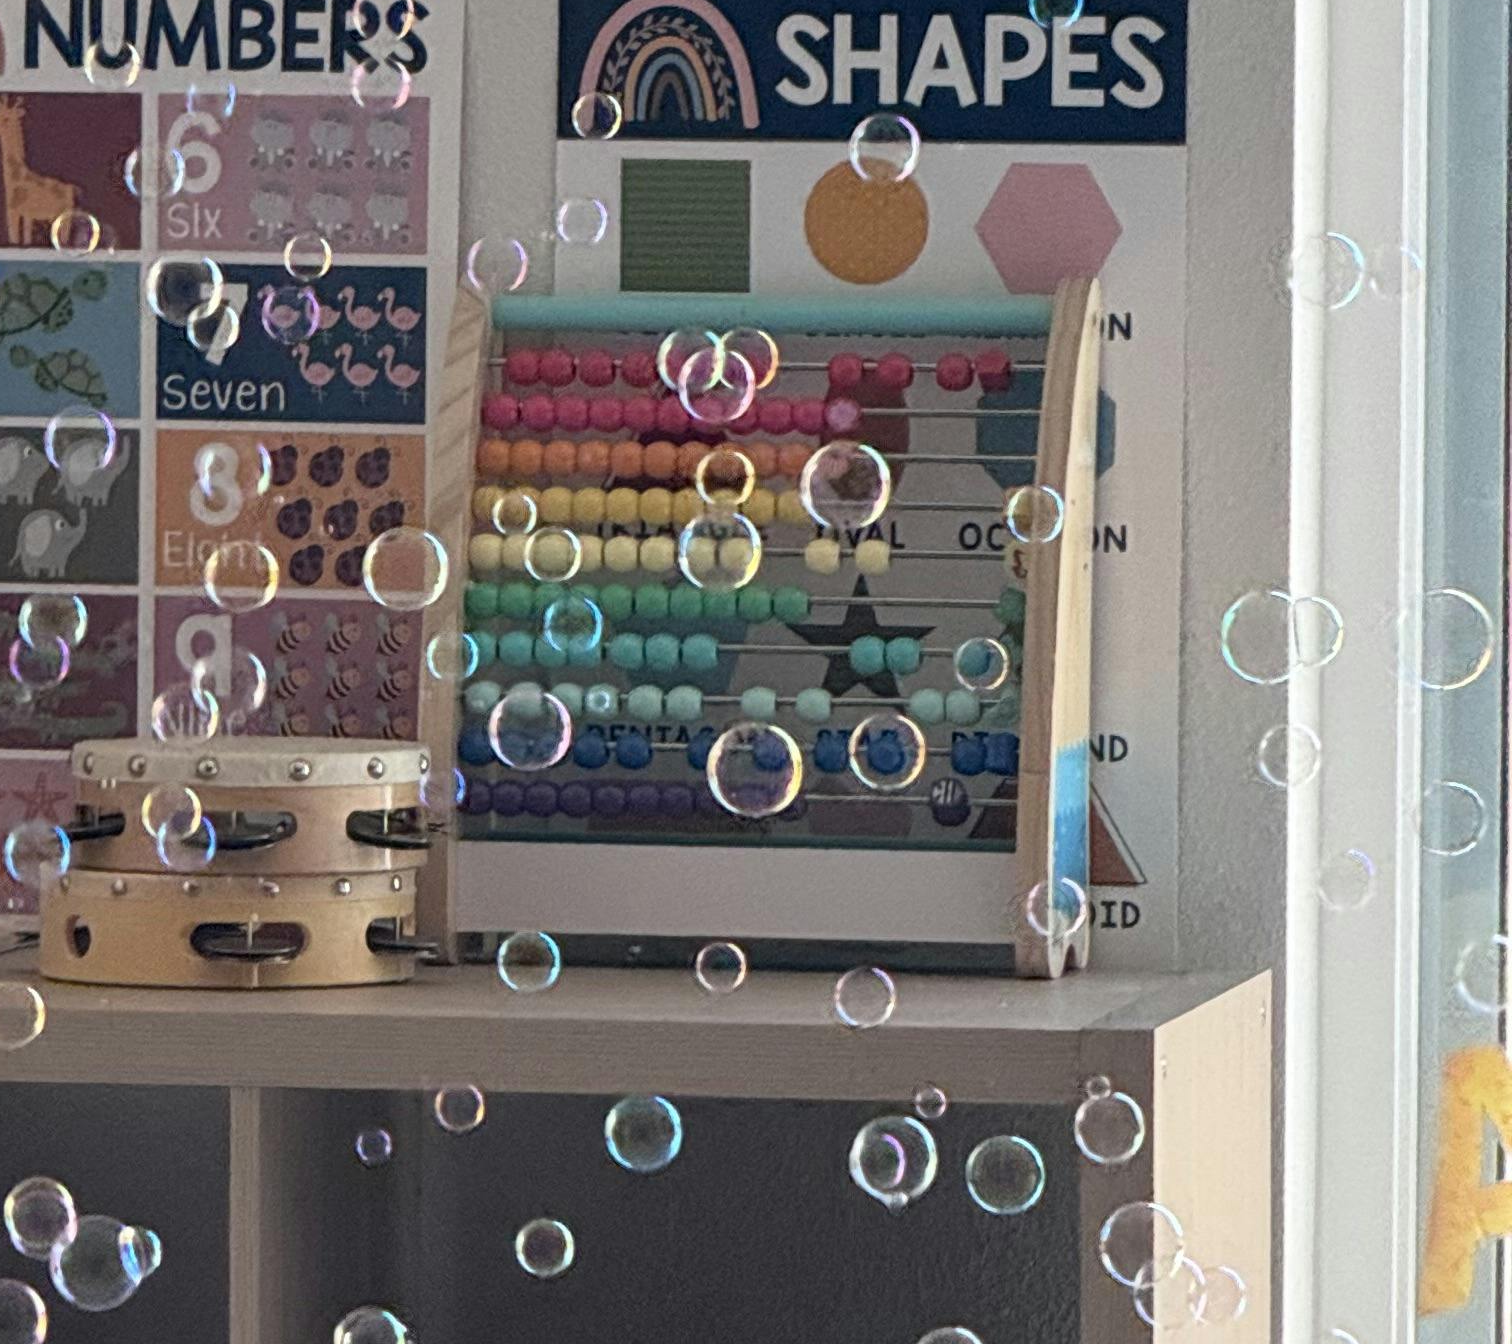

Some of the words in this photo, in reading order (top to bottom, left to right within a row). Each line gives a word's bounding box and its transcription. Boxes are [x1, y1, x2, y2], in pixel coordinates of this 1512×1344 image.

[775, 12, 1166, 110] SHAPES
[167, 111, 223, 194] 6
[199, 283, 249, 366] 7
[163, 374, 286, 412] Seven
[190, 443, 243, 526] 8
[175, 613, 233, 697] 9
